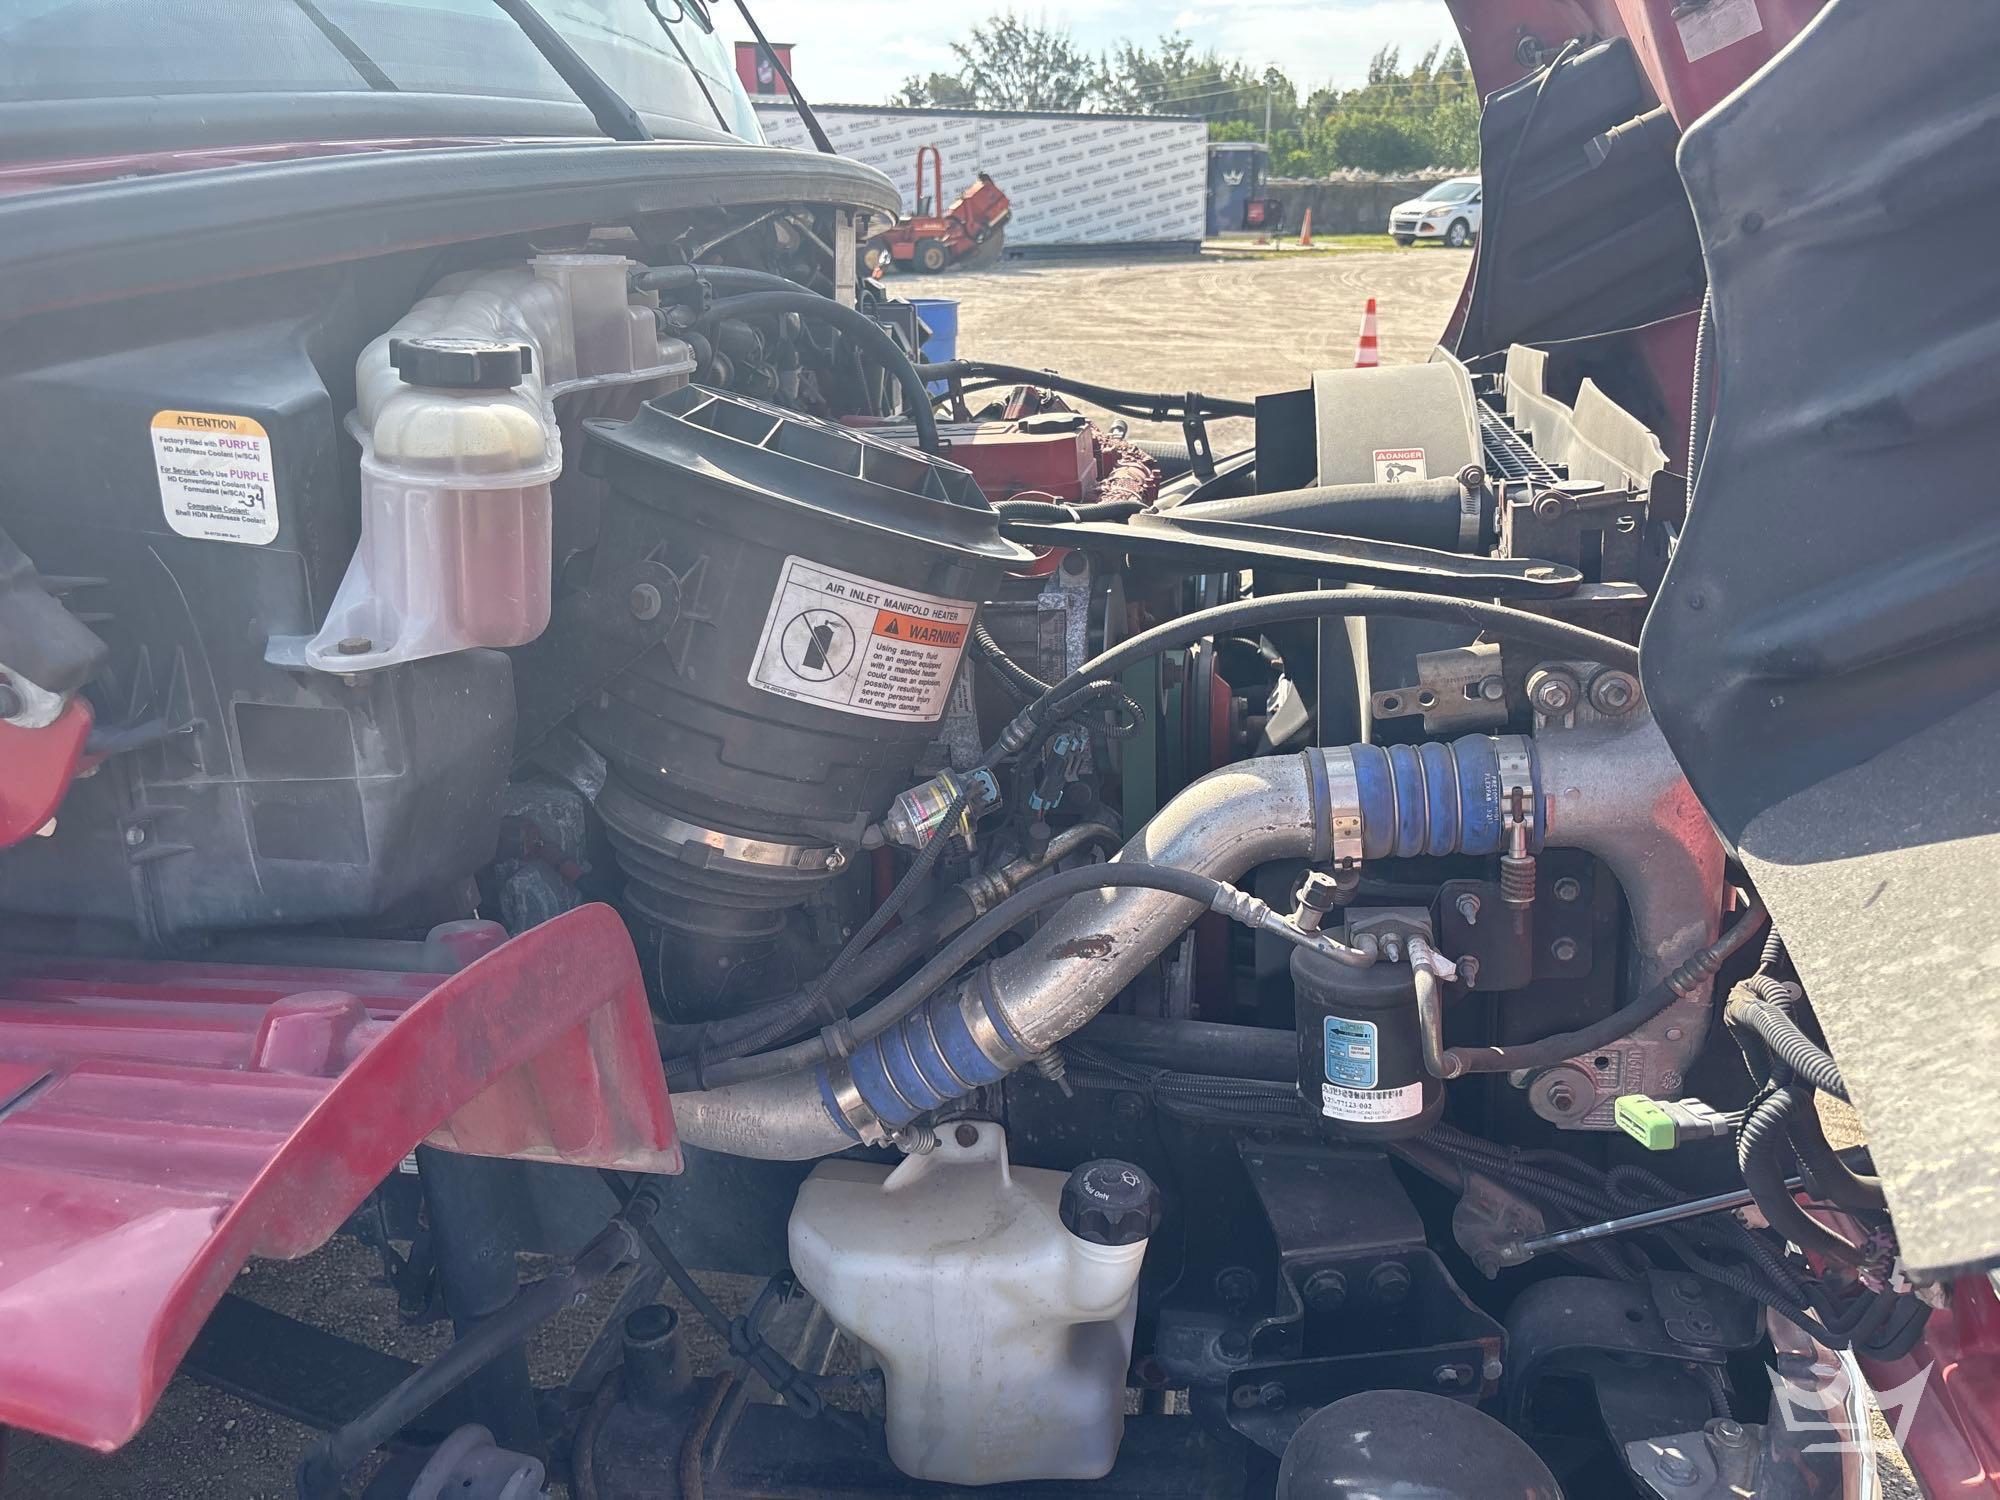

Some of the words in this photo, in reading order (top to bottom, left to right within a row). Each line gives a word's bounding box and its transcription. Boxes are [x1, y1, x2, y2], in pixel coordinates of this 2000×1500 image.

[177, 416, 236, 430] ATTENTION
[160, 436, 183, 445] Factory
[219, 439, 260, 451] PURPLE
[175, 447, 206, 455] Antifreeze
[235, 452, 260, 461] (w/SCA)
[1386, 452, 1422, 460] DANGER
[173, 467, 198, 476] Service:
[200, 469, 214, 478] Only
[230, 469, 269, 481] PURPLE
[178, 476, 220, 486] Conventional
[222, 480, 246, 488] Coolant
[184, 486, 219, 495] Formulated
[221, 489, 245, 498] (w/SCA)
[187, 502, 222, 511] Compatible
[210, 513, 240, 521] Antifreeze
[242, 516, 266, 524] Coolant
[826, 582, 845, 595] AIR
[849, 587, 880, 605] INLET
[884, 598, 930, 616] MANIFOLD
[932, 609, 958, 622] HEATER
[910, 624, 960, 644] WARNING
[876, 643, 897, 656] Using
[900, 649, 924, 660] starting
[870, 661, 885, 671] with
[894, 666, 920, 676] manifold
[896, 657, 917, 667] engine
[919, 660, 941, 670] equipped
[867, 670, 886, 680] could
[864, 679, 893, 690] possibly
[897, 684, 923, 695] resulting
[858, 696, 875, 706] and
[876, 701, 897, 710] engine
[862, 689, 885, 698] severe
[888, 693, 914, 703] personal
[916, 694, 930, 704] injury
[1094, 1190, 1110, 1200] Only
